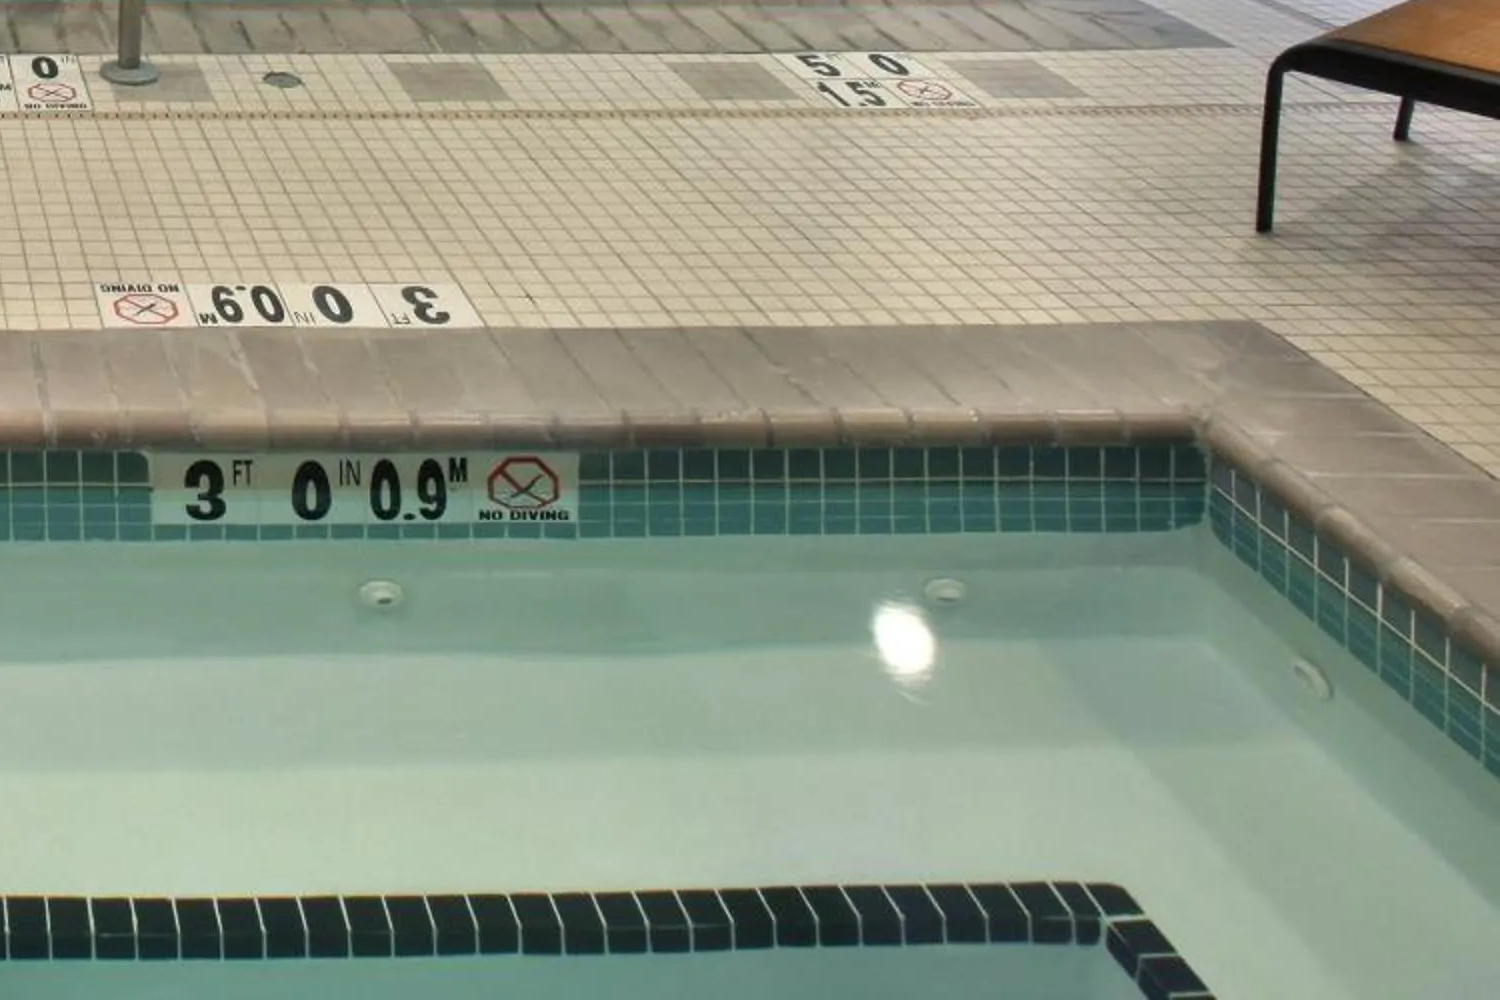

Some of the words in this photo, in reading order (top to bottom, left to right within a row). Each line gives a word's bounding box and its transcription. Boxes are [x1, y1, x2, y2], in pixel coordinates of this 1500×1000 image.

[31, 56, 59, 79] 0
[796, 54, 841, 77] 5
[868, 53, 910, 76] 0
[100, 284, 153, 293] DIVING
[158, 284, 180, 293] NO
[211, 285, 285, 323] 0.9
[312, 285, 354, 323] 0
[401, 286, 451, 325] 3
[199, 312, 219, 324] M
[294, 311, 315, 325] IN
[391, 312, 411, 325] FT
[184, 459, 227, 520] 3
[232, 459, 253, 487] FT
[291, 460, 331, 521] 0
[339, 457, 360, 486] IN
[370, 459, 447, 521] 0.9
[448, 457, 468, 483] M
[479, 509, 503, 520] NO
[510, 509, 569, 520] DIVING
